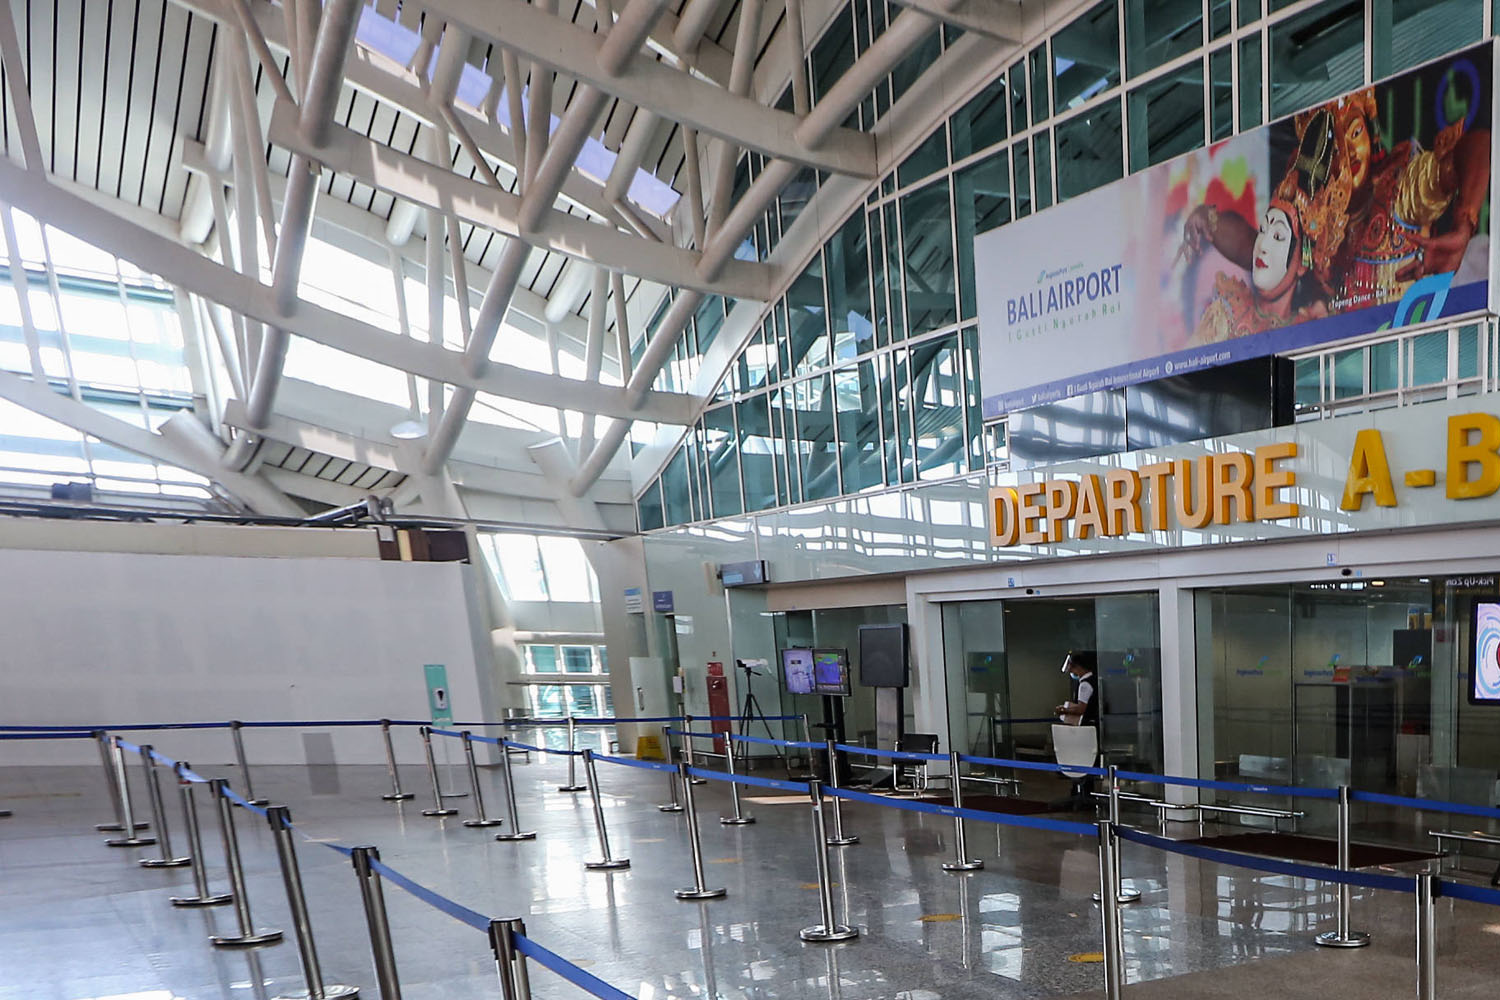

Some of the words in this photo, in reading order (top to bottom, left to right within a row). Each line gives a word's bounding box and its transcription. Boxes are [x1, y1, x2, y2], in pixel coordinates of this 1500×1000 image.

[1007, 289, 1043, 326] BALI
[1047, 263, 1122, 314] AIRPORT
[988, 443, 1298, 546] DEPARTURE
